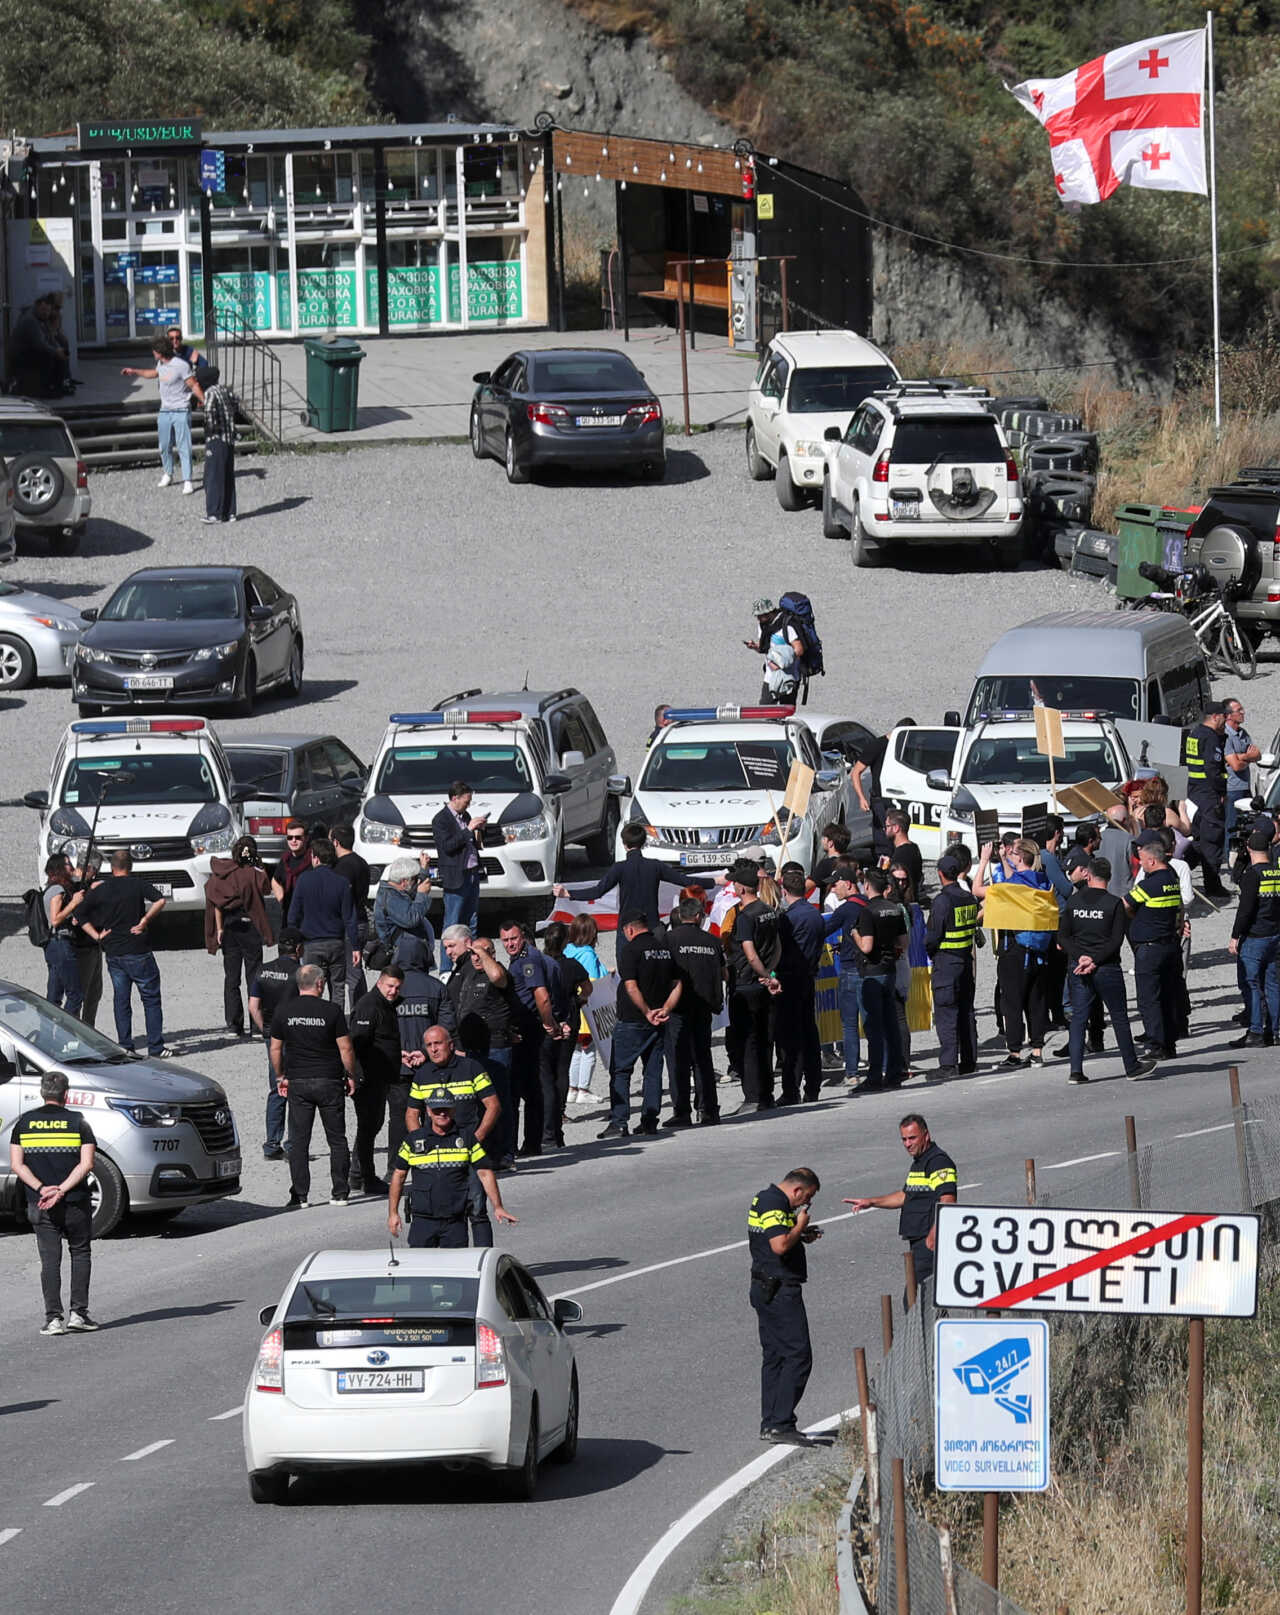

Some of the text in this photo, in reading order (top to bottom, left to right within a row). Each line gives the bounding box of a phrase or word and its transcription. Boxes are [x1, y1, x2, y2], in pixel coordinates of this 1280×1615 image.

[324, 140, 332, 150] 3
[415, 136, 422, 146] 4
[247, 143, 254, 153] 2
[373, 309, 436, 321] ISURANCE
[453, 304, 517, 318] ISURANCE
[283, 313, 351, 326] ISURANCE
[669, 798, 761, 808] POLICE
[687, 853, 731, 864] GG-139-SG
[1073, 909, 1104, 919] POLICE
[287, 1017, 326, 1026] პოლიცია
[29, 1120, 67, 1129] POLICE
[153, 1139, 180, 1151] 7707
[955, 1215, 1240, 1262] გველეთი
[953, 1260, 1177, 1306] GVELETI
[994, 1350, 1018, 1374] 24/7
[944, 1440, 1041, 1452] ვიდეო კონტროლი
[944, 1460, 1041, 1473] VIDEO SURVEILLANCE
